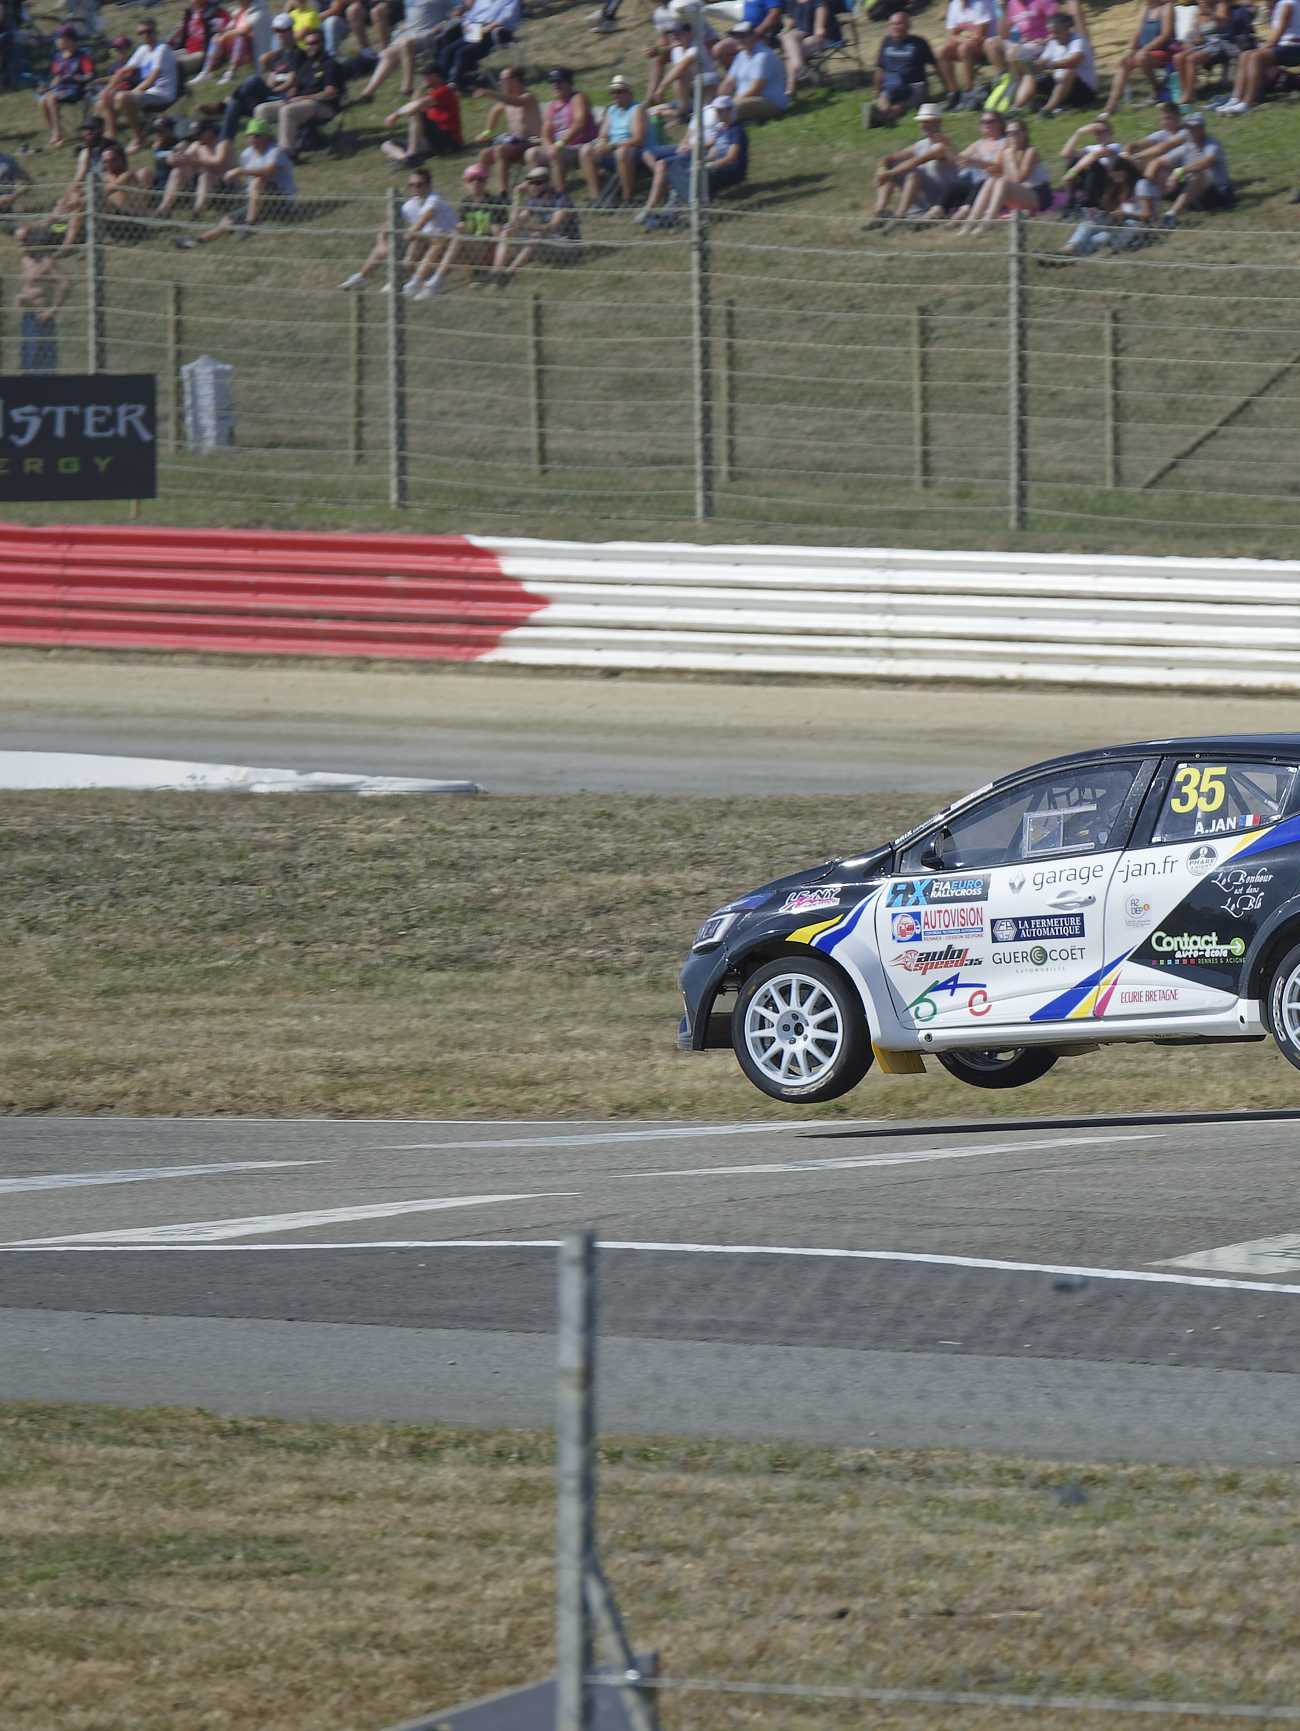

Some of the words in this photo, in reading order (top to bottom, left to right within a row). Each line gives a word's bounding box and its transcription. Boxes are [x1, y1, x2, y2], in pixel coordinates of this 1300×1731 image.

[0, 398, 153, 447] STER
[1171, 767, 1228, 814] 35
[1194, 816, 1237, 835] A.JAN
[930, 887, 982, 898] RALLYCROSS
[923, 907, 983, 930] AUTOVISION
[1018, 920, 1029, 929] LA
[1031, 917, 1081, 928] FERMETURE
[1021, 925, 1081, 938] AUTOMATIQUE
[1151, 930, 1218, 952] Contact
[916, 944, 963, 962] auto
[1145, 989, 1179, 1002] BRETAGNE
